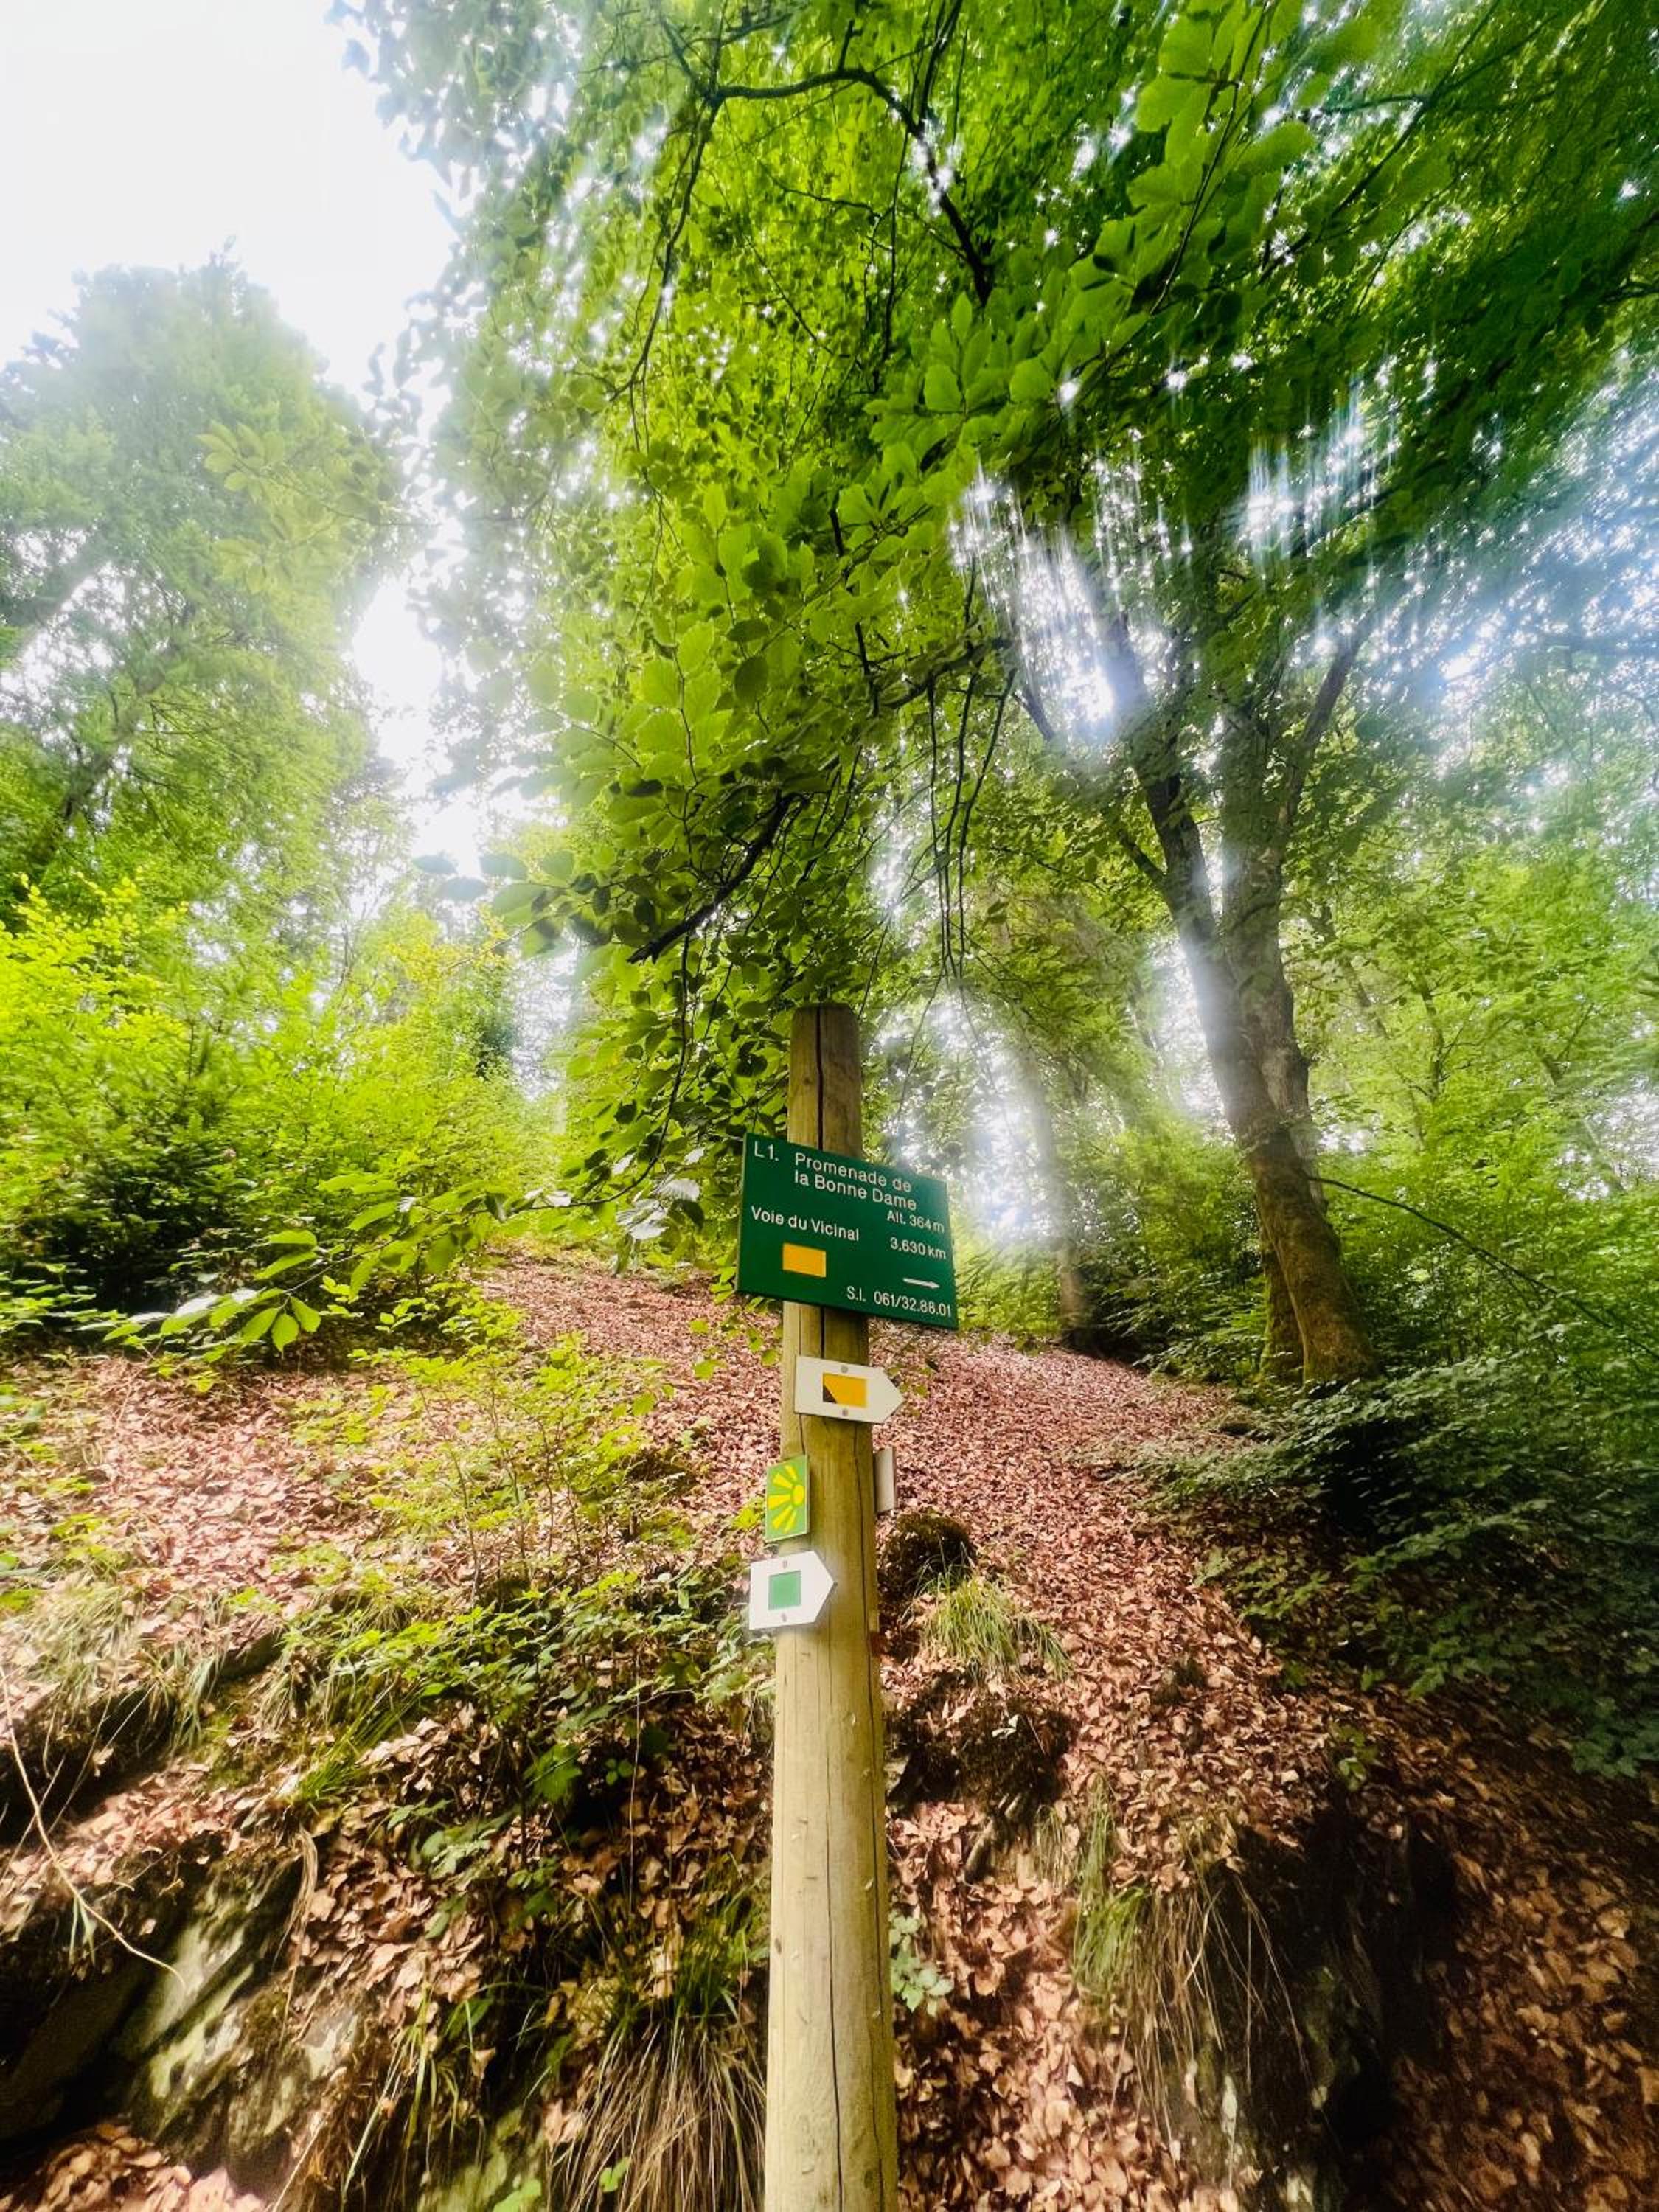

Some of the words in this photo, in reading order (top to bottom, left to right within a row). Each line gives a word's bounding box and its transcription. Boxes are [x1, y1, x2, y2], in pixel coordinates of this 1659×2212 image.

[754, 1141, 779, 1161] L1.
[794, 1152, 887, 1186] Promenade
[891, 1178, 912, 1192] de
[794, 1170, 809, 1186] la
[815, 1174, 868, 1199] Bonne
[872, 1188, 917, 1211] Dame
[751, 1206, 784, 1225] Voie
[788, 1215, 807, 1230] du
[810, 1219, 860, 1242] Vicinal
[887, 1210, 906, 1225] Alt.
